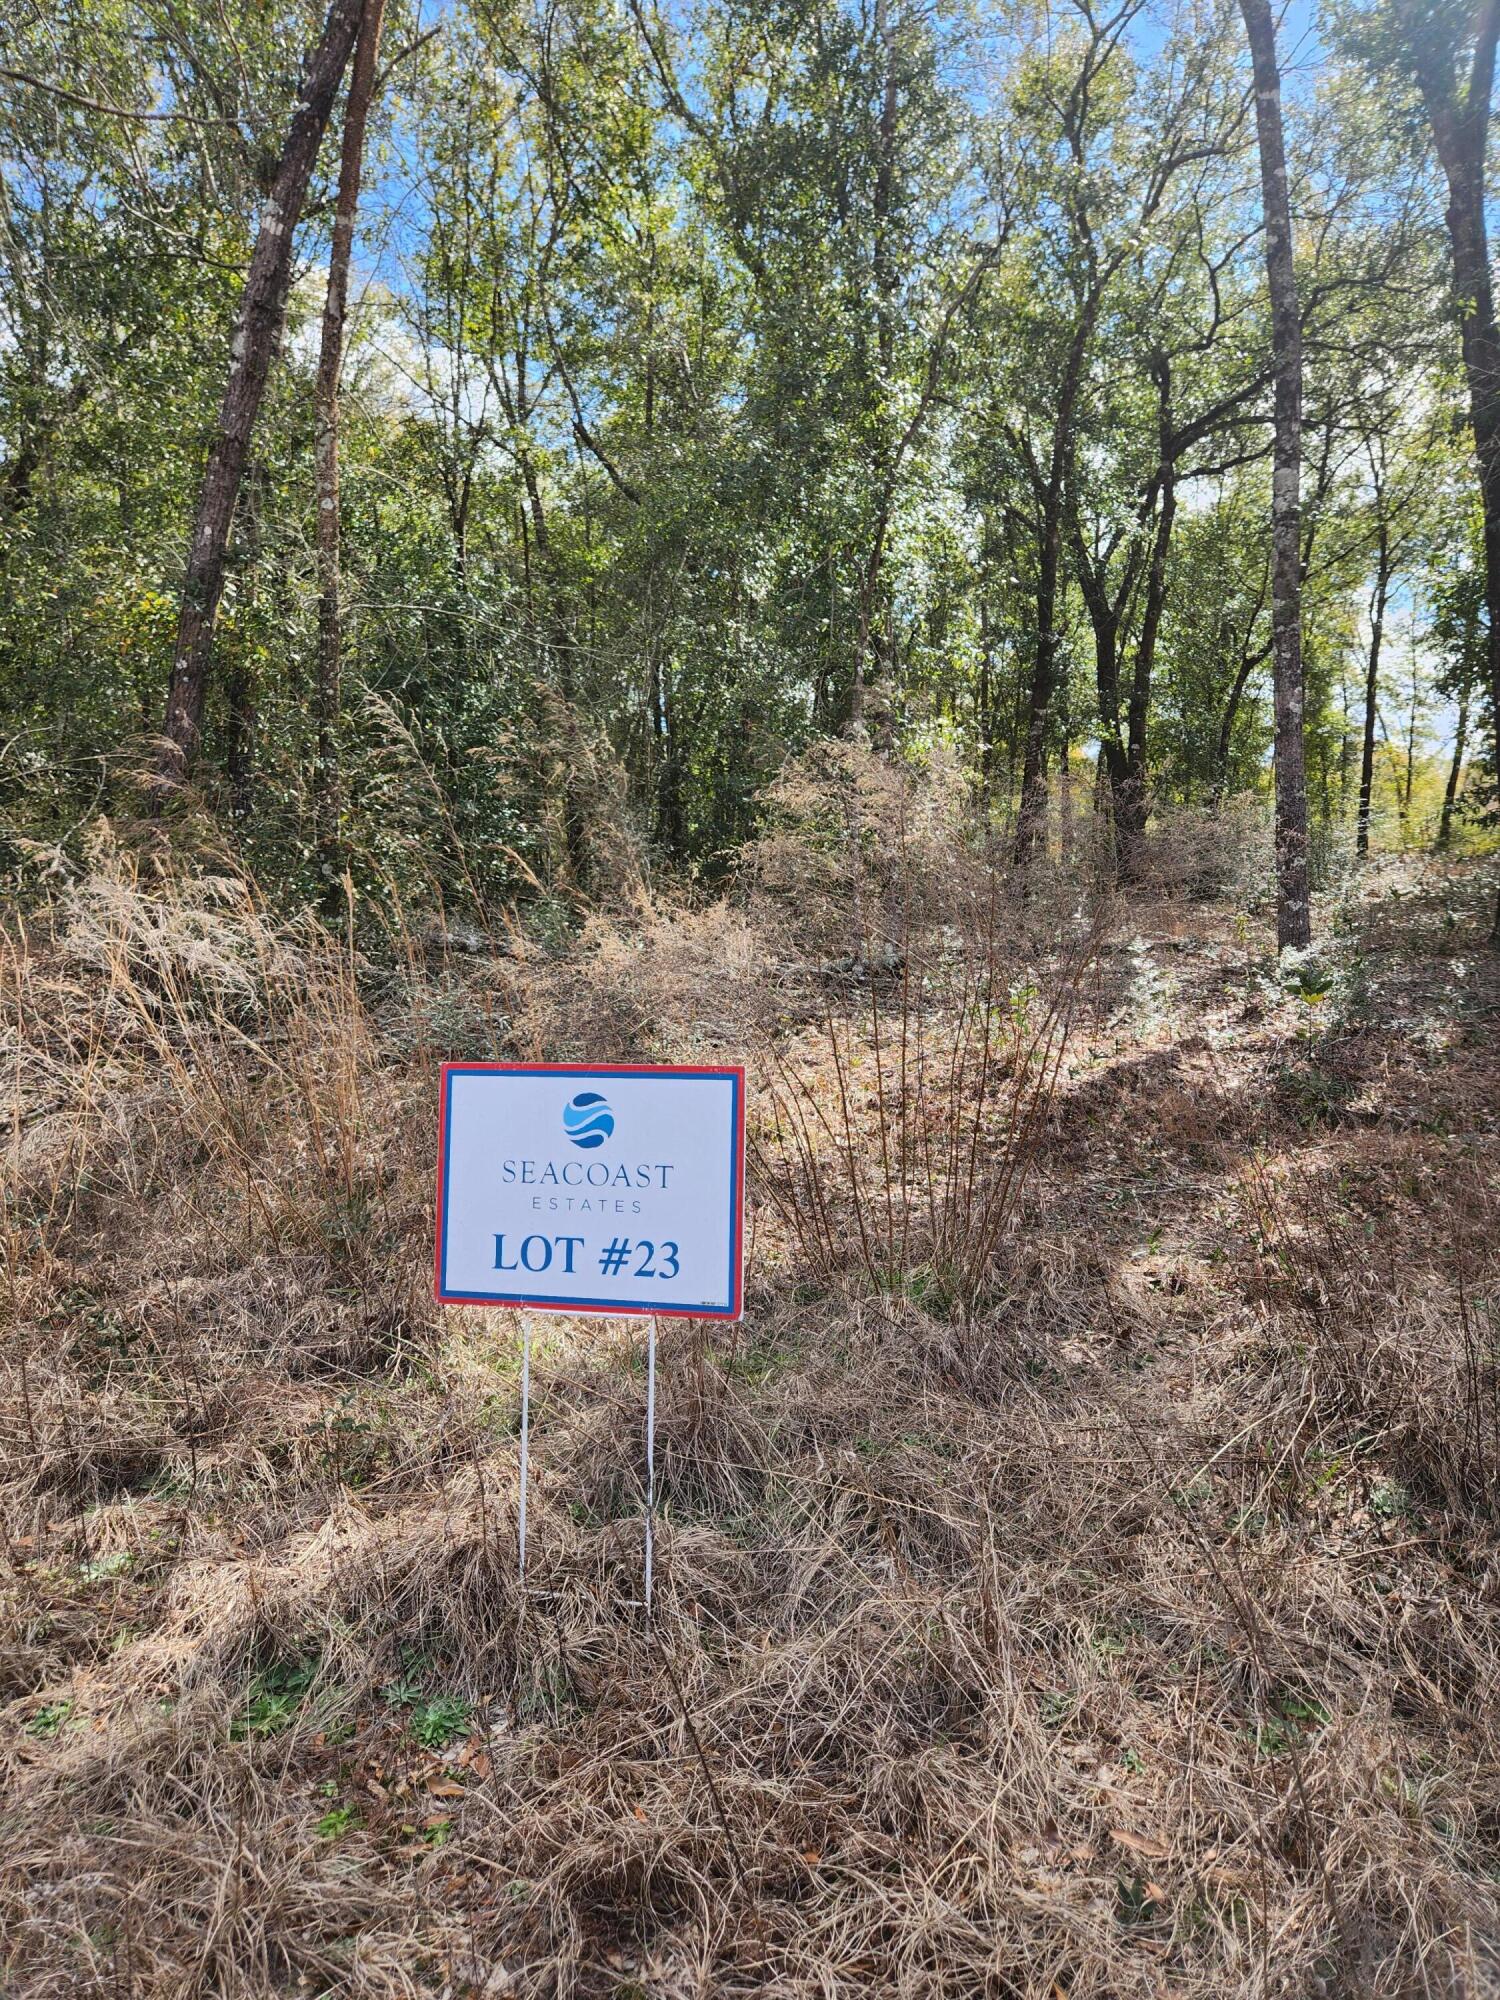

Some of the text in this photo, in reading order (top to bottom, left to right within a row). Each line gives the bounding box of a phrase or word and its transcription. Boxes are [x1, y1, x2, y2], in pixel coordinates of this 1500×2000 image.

[502, 1160, 674, 1189] SEACOAST
[532, 1196, 641, 1214] ESTATES
[492, 1233, 680, 1280] LOT #23
